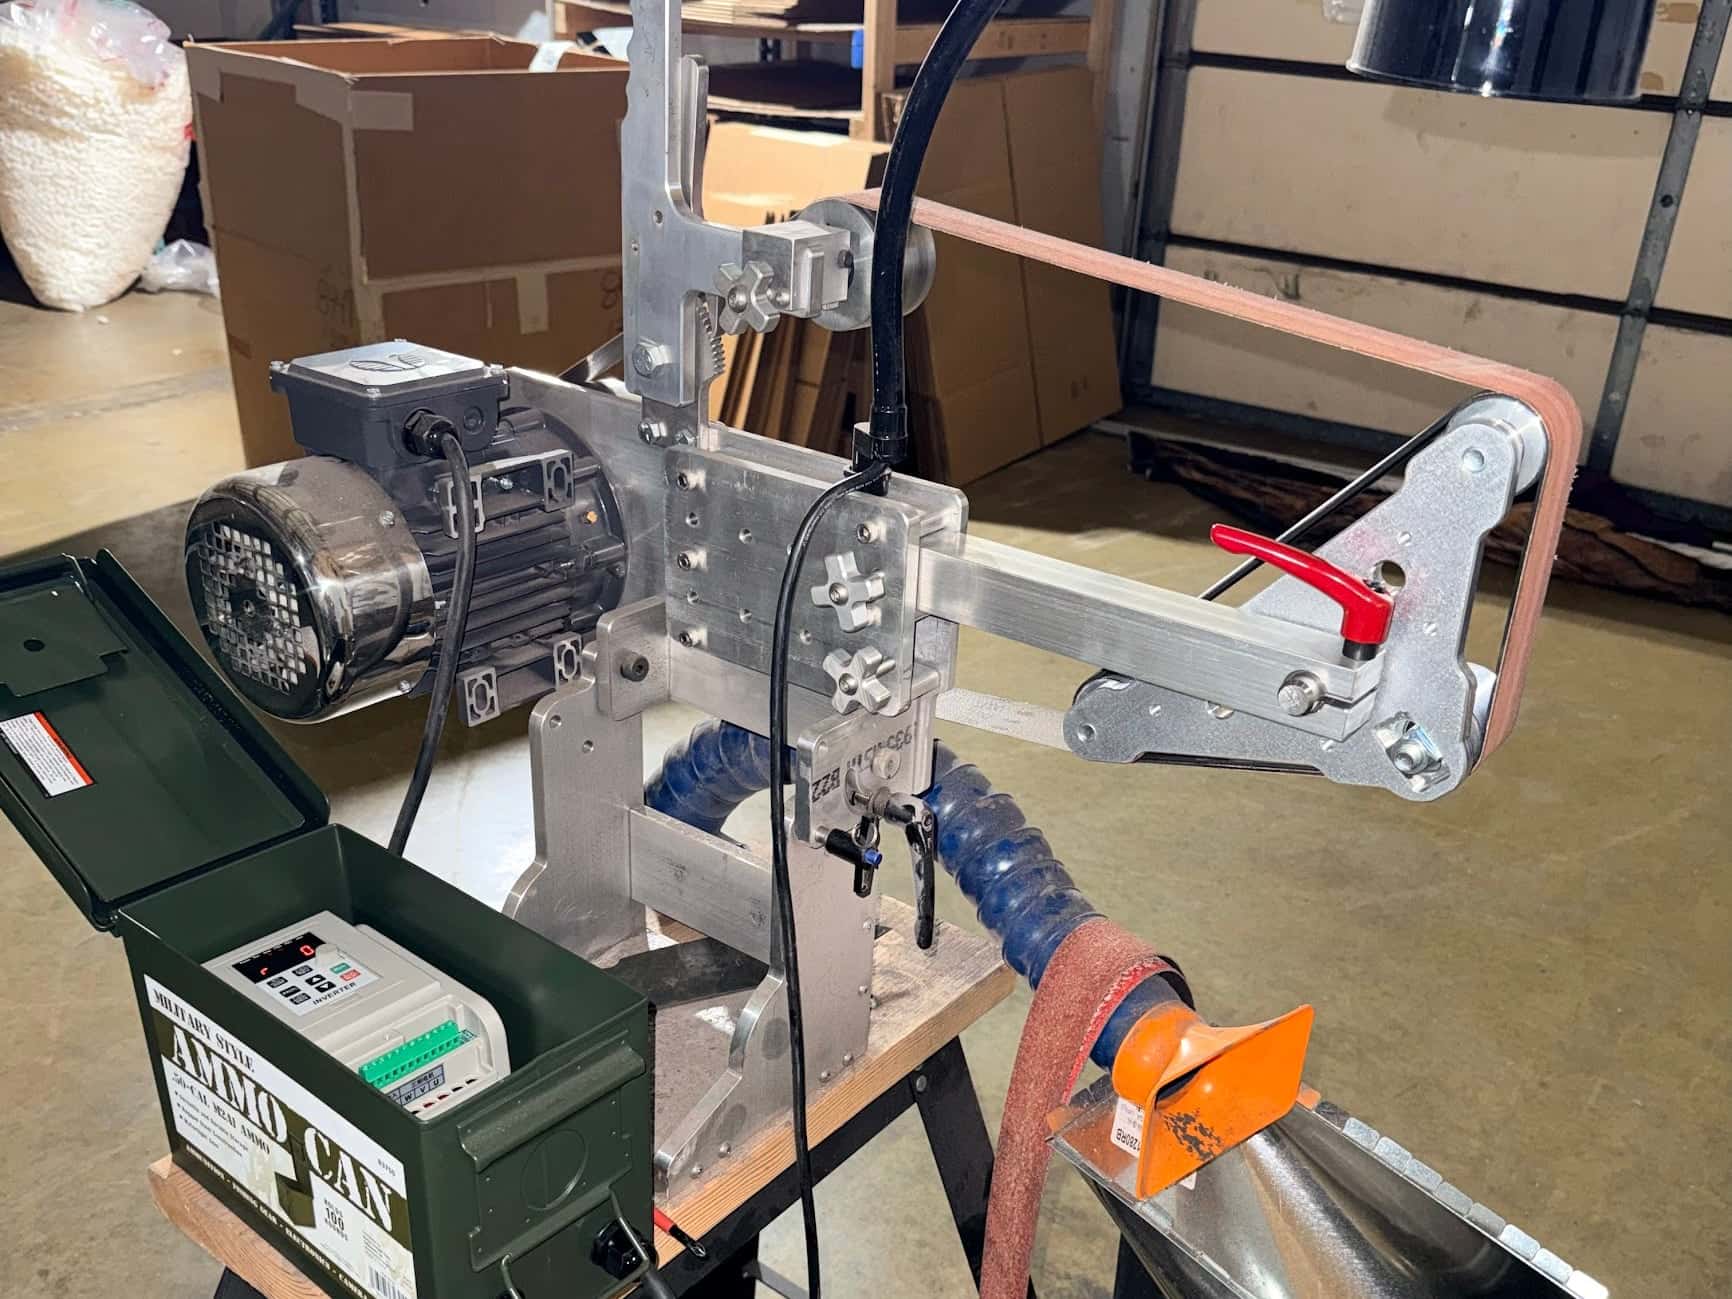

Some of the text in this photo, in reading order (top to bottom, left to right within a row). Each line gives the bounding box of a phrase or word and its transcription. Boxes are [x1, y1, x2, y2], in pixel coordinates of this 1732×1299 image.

[312, 981, 357, 1005] INVERTER
[154, 989, 256, 1074] MILITARY STYLE
[433, 1078, 440, 1086] U
[171, 1025, 288, 1144] AMMO
[304, 1127, 393, 1233] CAN
[240, 1124, 270, 1155] AMMO
[325, 1207, 345, 1232] 100
